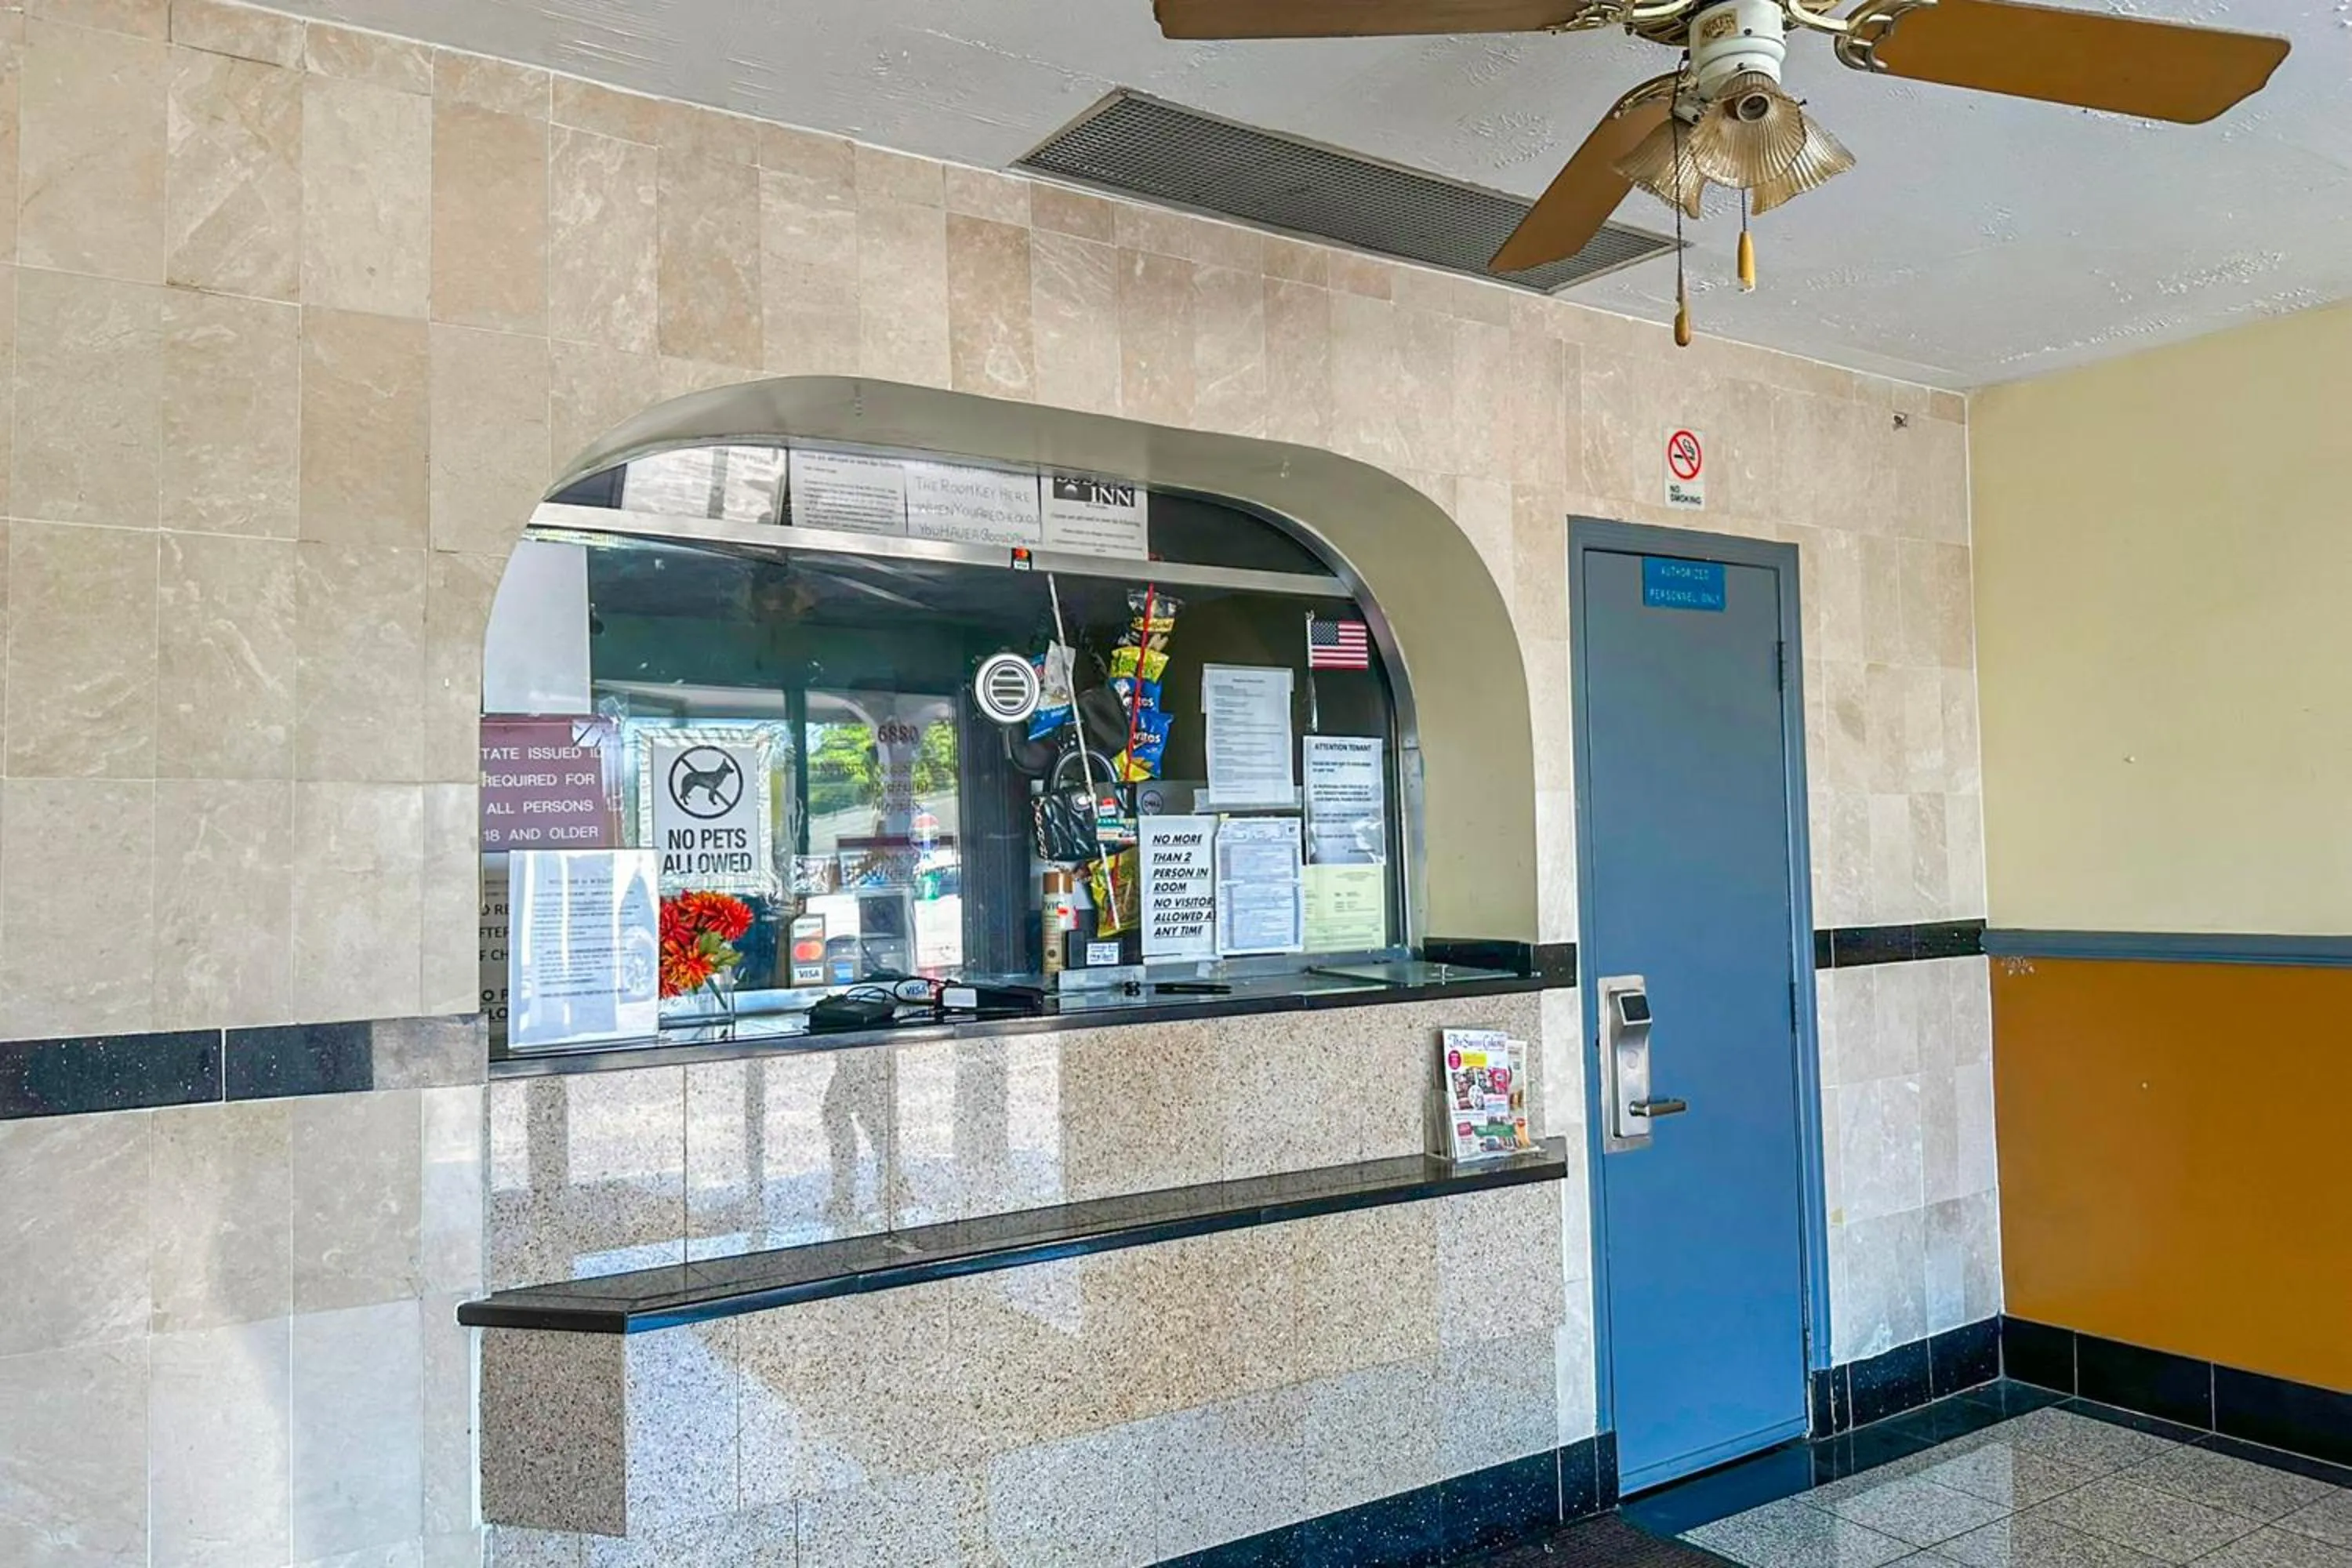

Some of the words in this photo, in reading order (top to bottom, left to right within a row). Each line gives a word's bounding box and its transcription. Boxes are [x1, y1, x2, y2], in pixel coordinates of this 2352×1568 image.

[1091, 486, 1133, 507] INN
[1315, 742, 1347, 751] ATTENTION
[528, 746, 582, 760] ISSUED
[482, 773, 557, 787] REQUIRED
[565, 773, 595, 786] FOR
[485, 802, 515, 815] ALL
[523, 800, 593, 813] PERSONS
[485, 829, 500, 841] 18
[509, 828, 541, 840] AND
[550, 826, 599, 840] OLDER
[668, 829, 695, 850] NO
[701, 828, 747, 849] PETS
[1152, 833, 1171, 845] NO
[1172, 833, 1203, 844] MORE
[1153, 852, 1182, 863] THAN
[1185, 852, 1192, 862] 2
[662, 853, 753, 875] ALLOWED
[1153, 868, 1194, 879] PERSON
[1196, 867, 1209, 878] IN
[1153, 882, 1187, 892] ROOM
[1153, 898, 1172, 908] NO
[1153, 911, 1203, 923] ALLOWED
[1153, 925, 1178, 938] ANY
[1181, 924, 1203, 936] TIME
[797, 969, 820, 978] VISA
[905, 985, 927, 995] VISA
